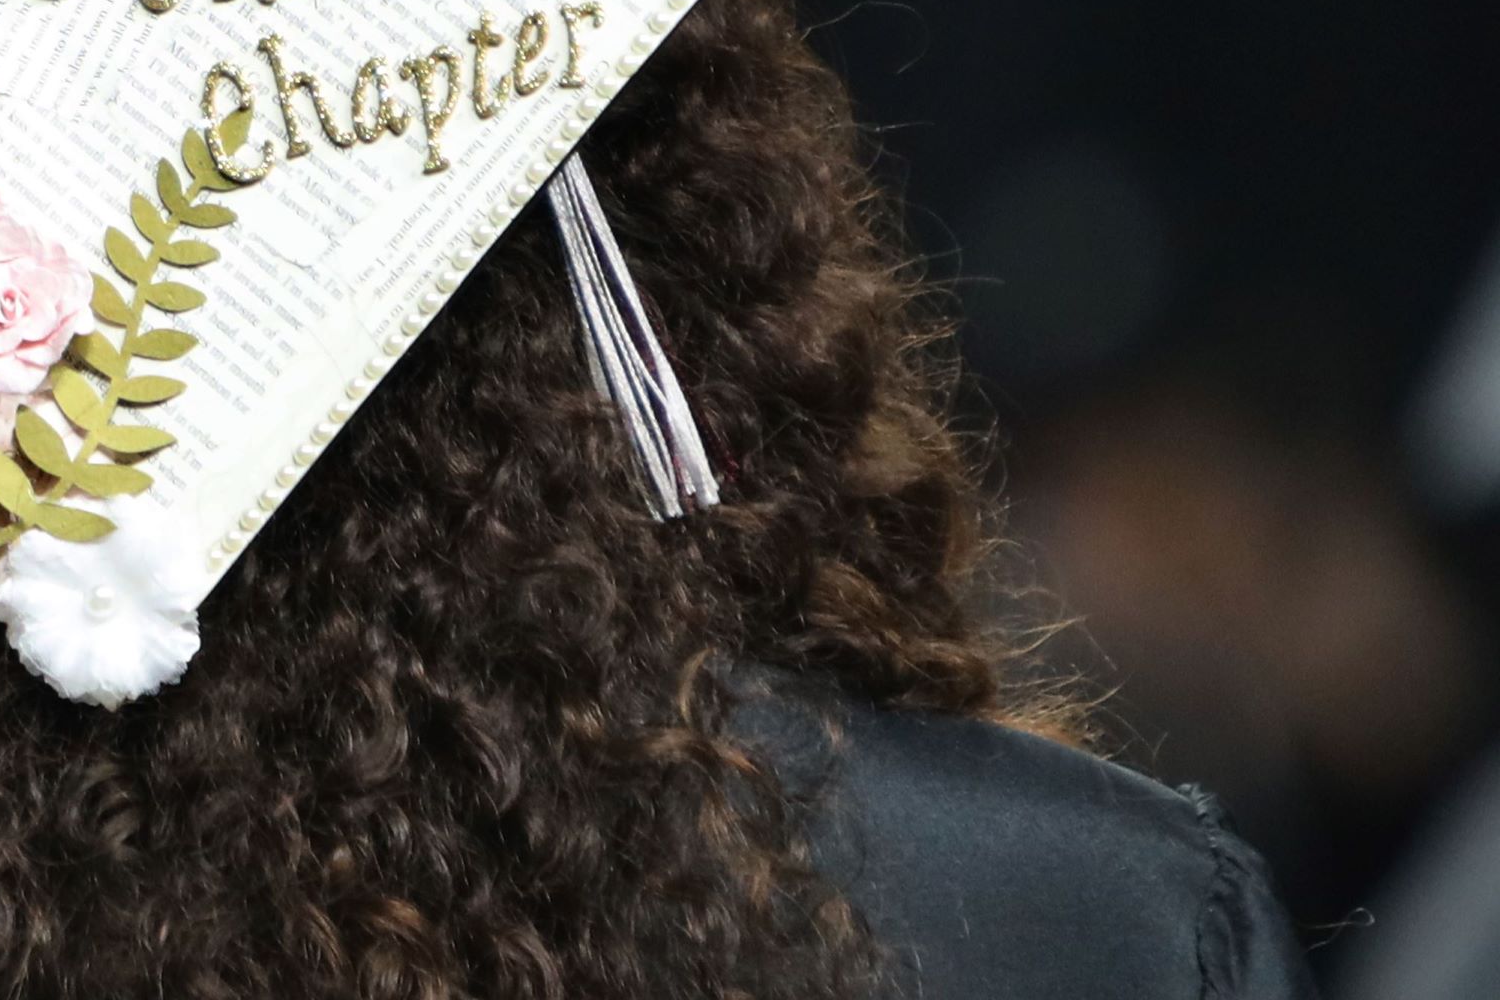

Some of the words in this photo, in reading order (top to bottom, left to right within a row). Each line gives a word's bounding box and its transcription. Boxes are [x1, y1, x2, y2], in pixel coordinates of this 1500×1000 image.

[48, 38, 67, 66] into
[104, 20, 128, 60] could
[67, 47, 88, 76] slow
[202, 1, 605, 182] Chapter
